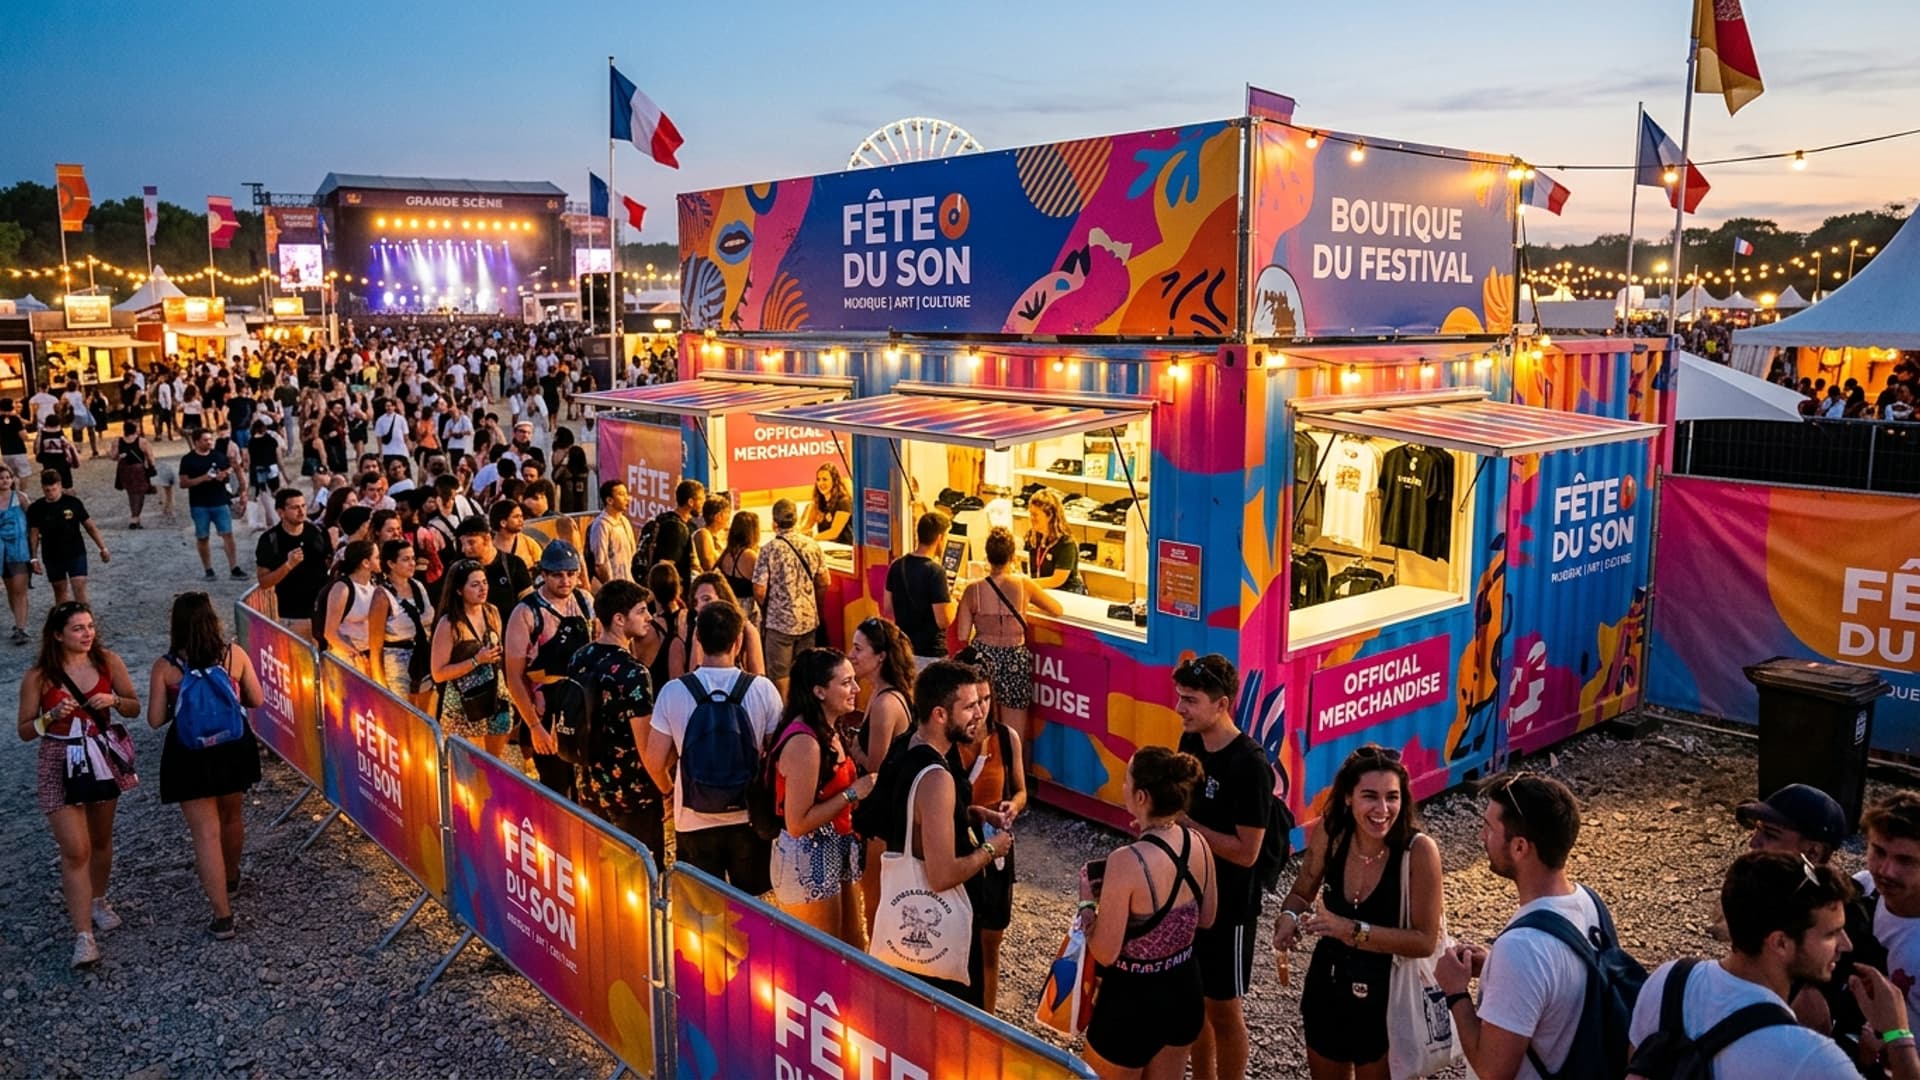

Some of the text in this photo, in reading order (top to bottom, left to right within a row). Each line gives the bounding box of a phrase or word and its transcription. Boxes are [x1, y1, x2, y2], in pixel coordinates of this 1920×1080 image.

[843, 188, 936, 246] FÊTE
[1331, 197, 1463, 243] BOUTIQUE
[843, 246, 970, 288] DU SON
[1313, 244, 1473, 284] DU FESTIVAL
[894, 296, 914, 309] ART
[922, 295, 971, 309] CULTURE
[627, 457, 670, 501] FÊTE
[1553, 472, 1620, 525] FÊTE
[1552, 526, 1584, 563] DU
[1588, 515, 1635, 554] SON
[1838, 621, 1916, 663] DU
[1031, 653, 1070, 684] IAL
[1343, 653, 1422, 695] OFFICIAL
[1318, 672, 1441, 732] MERCHANDISE
[355, 708, 401, 775] FÊTE
[502, 816, 576, 908] FÊTE
[505, 868, 527, 902] DU
[530, 886, 577, 950] SON
